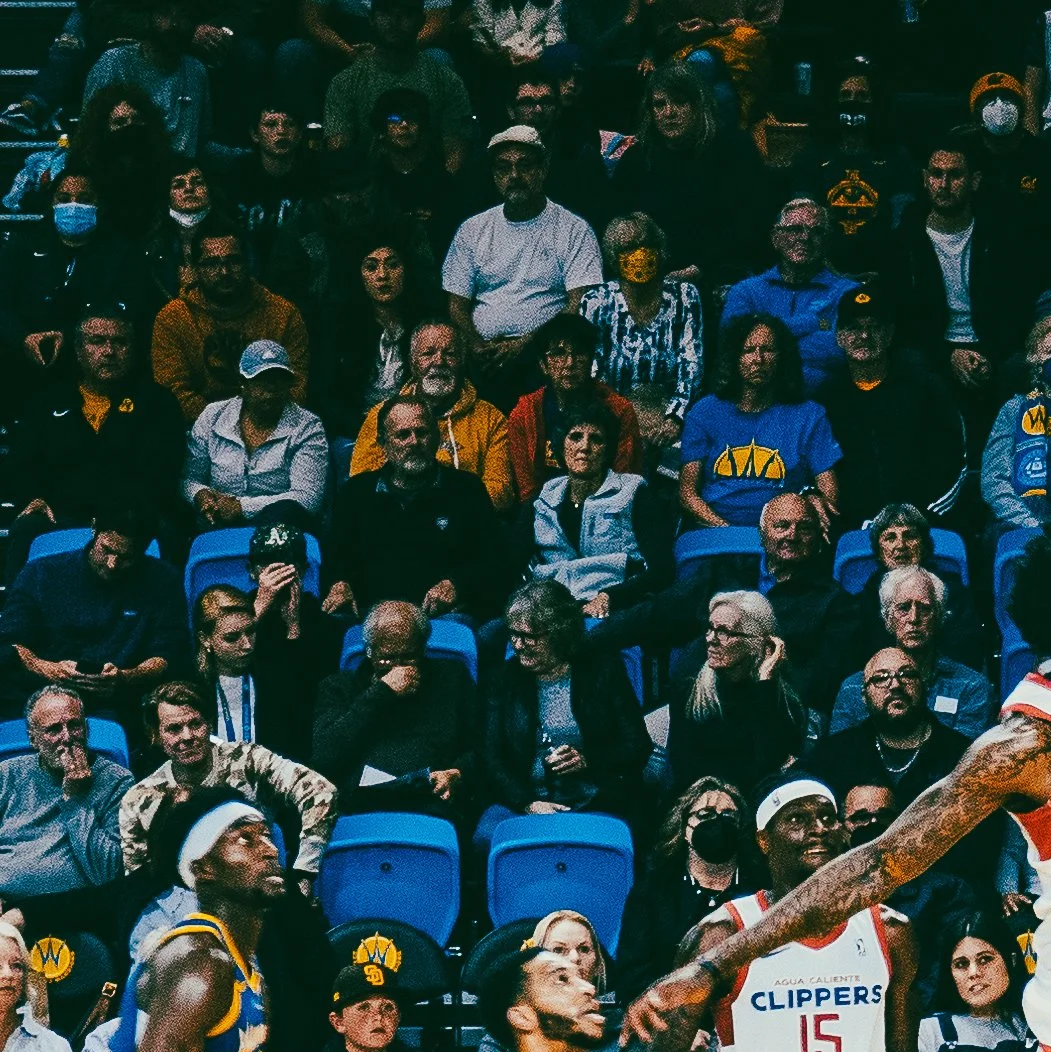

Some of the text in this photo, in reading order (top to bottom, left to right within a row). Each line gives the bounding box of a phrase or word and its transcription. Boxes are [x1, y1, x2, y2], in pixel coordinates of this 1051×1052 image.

[773, 974, 861, 987] AGUA CALIENTE
[750, 984, 883, 1012] CLIPPERS
